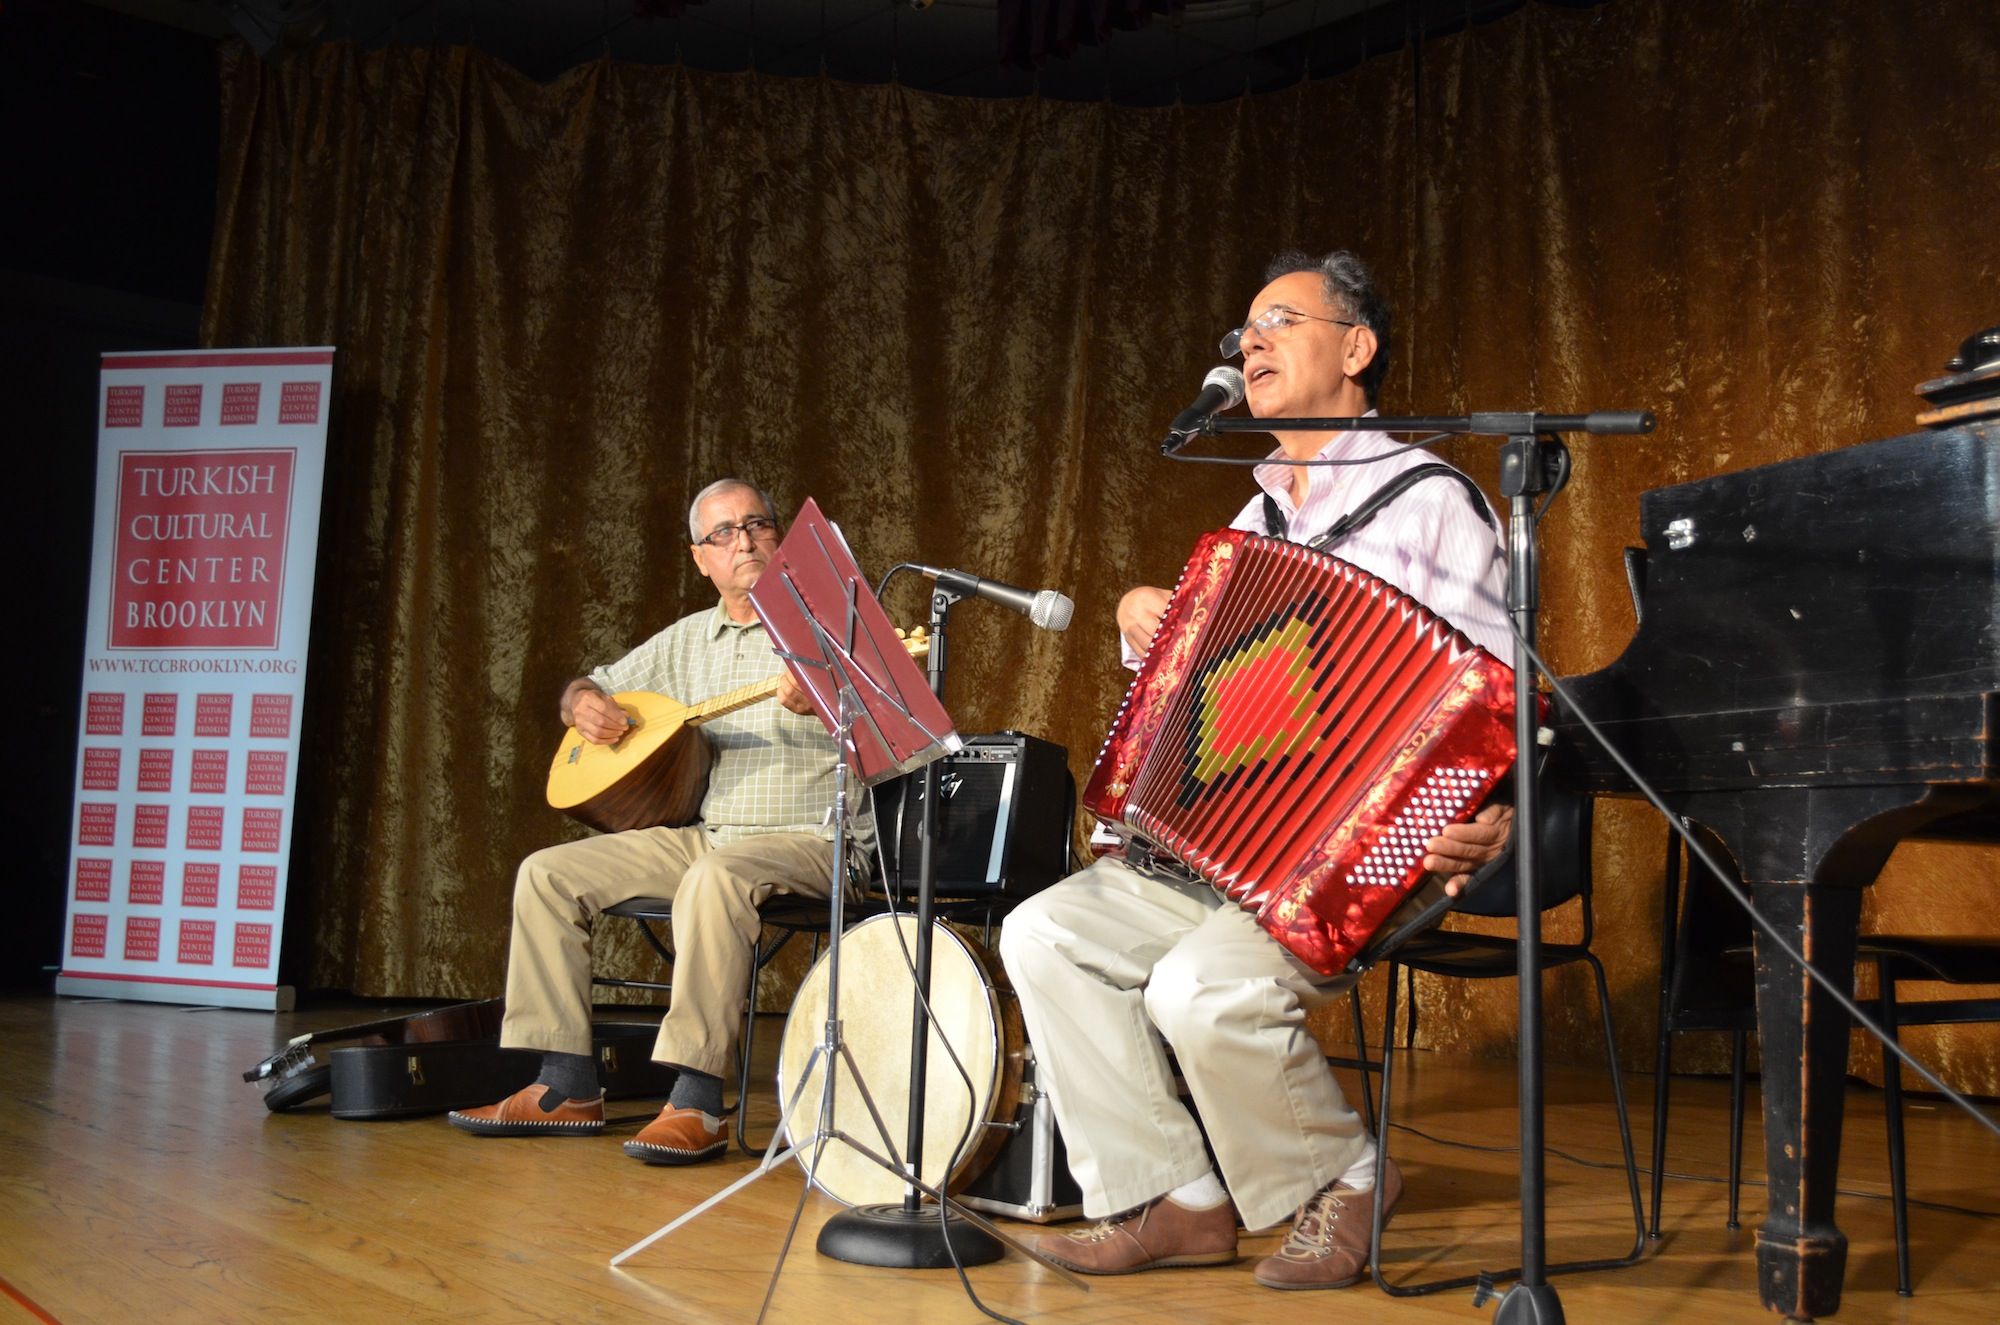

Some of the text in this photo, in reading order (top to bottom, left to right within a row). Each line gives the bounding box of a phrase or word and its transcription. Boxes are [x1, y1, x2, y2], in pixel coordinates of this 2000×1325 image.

[134, 465, 275, 496] TURKISH
[131, 512, 273, 540] CULTURAL
[128, 557, 270, 584] CENTER
[127, 600, 266, 628] BROOKLYN
[89, 658, 297, 674] WWW.TCCBROOKLYN.ORG
